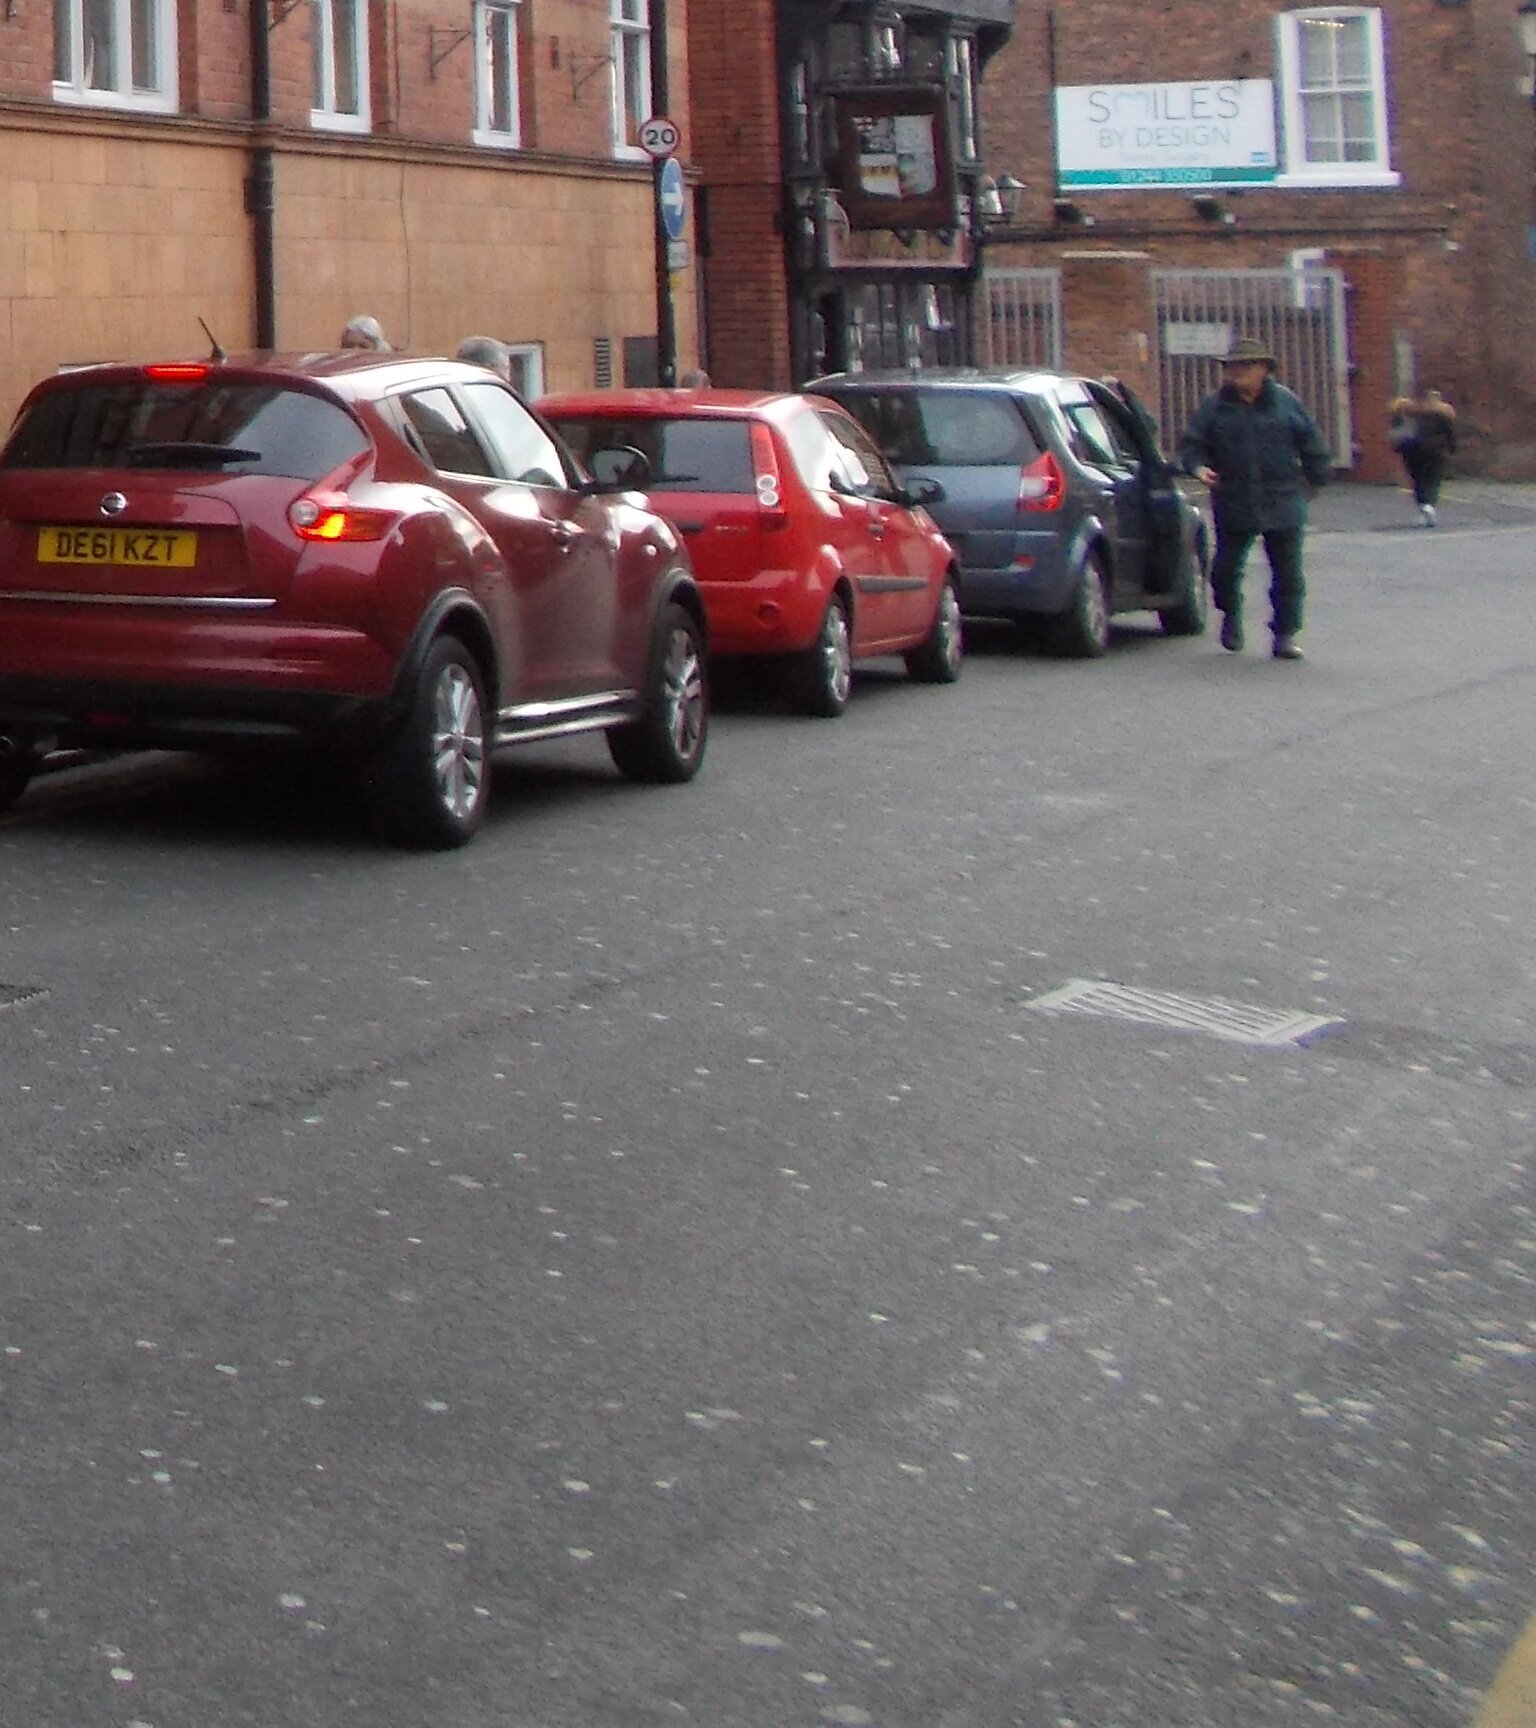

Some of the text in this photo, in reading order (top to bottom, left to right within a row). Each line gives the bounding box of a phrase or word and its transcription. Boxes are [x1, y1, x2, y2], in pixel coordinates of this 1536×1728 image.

[1088, 85, 1240, 123] SMILES
[645, 128, 675, 145] 20
[1099, 126, 1231, 148] BY DESIGN
[55, 531, 178, 561] DE61 KZT
